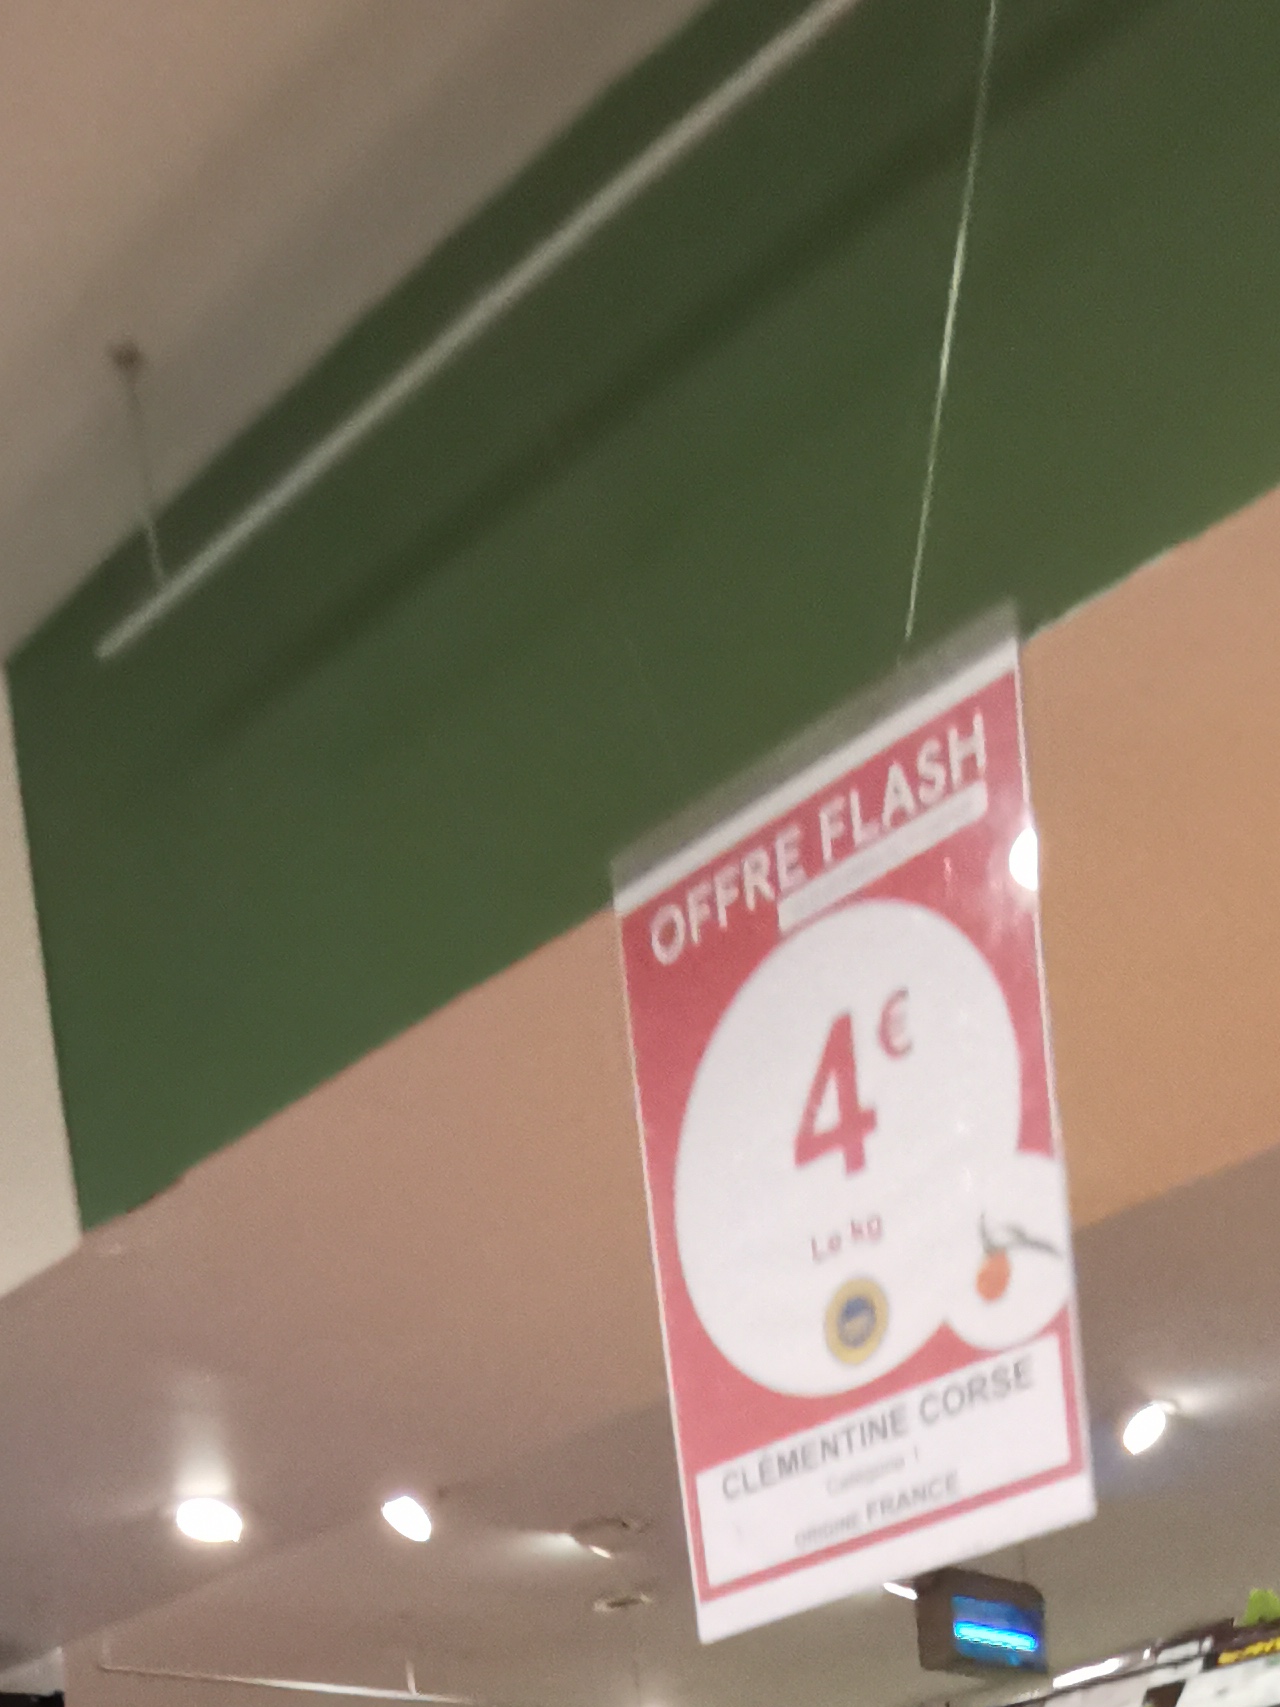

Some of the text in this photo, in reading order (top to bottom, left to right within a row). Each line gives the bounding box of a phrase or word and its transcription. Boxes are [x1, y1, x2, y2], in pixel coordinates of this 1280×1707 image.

[651, 707, 986, 966] OFFRE FLASH
[920, 1355, 1035, 1426] CORSE
[865, 1471, 961, 1526] FRANCE
